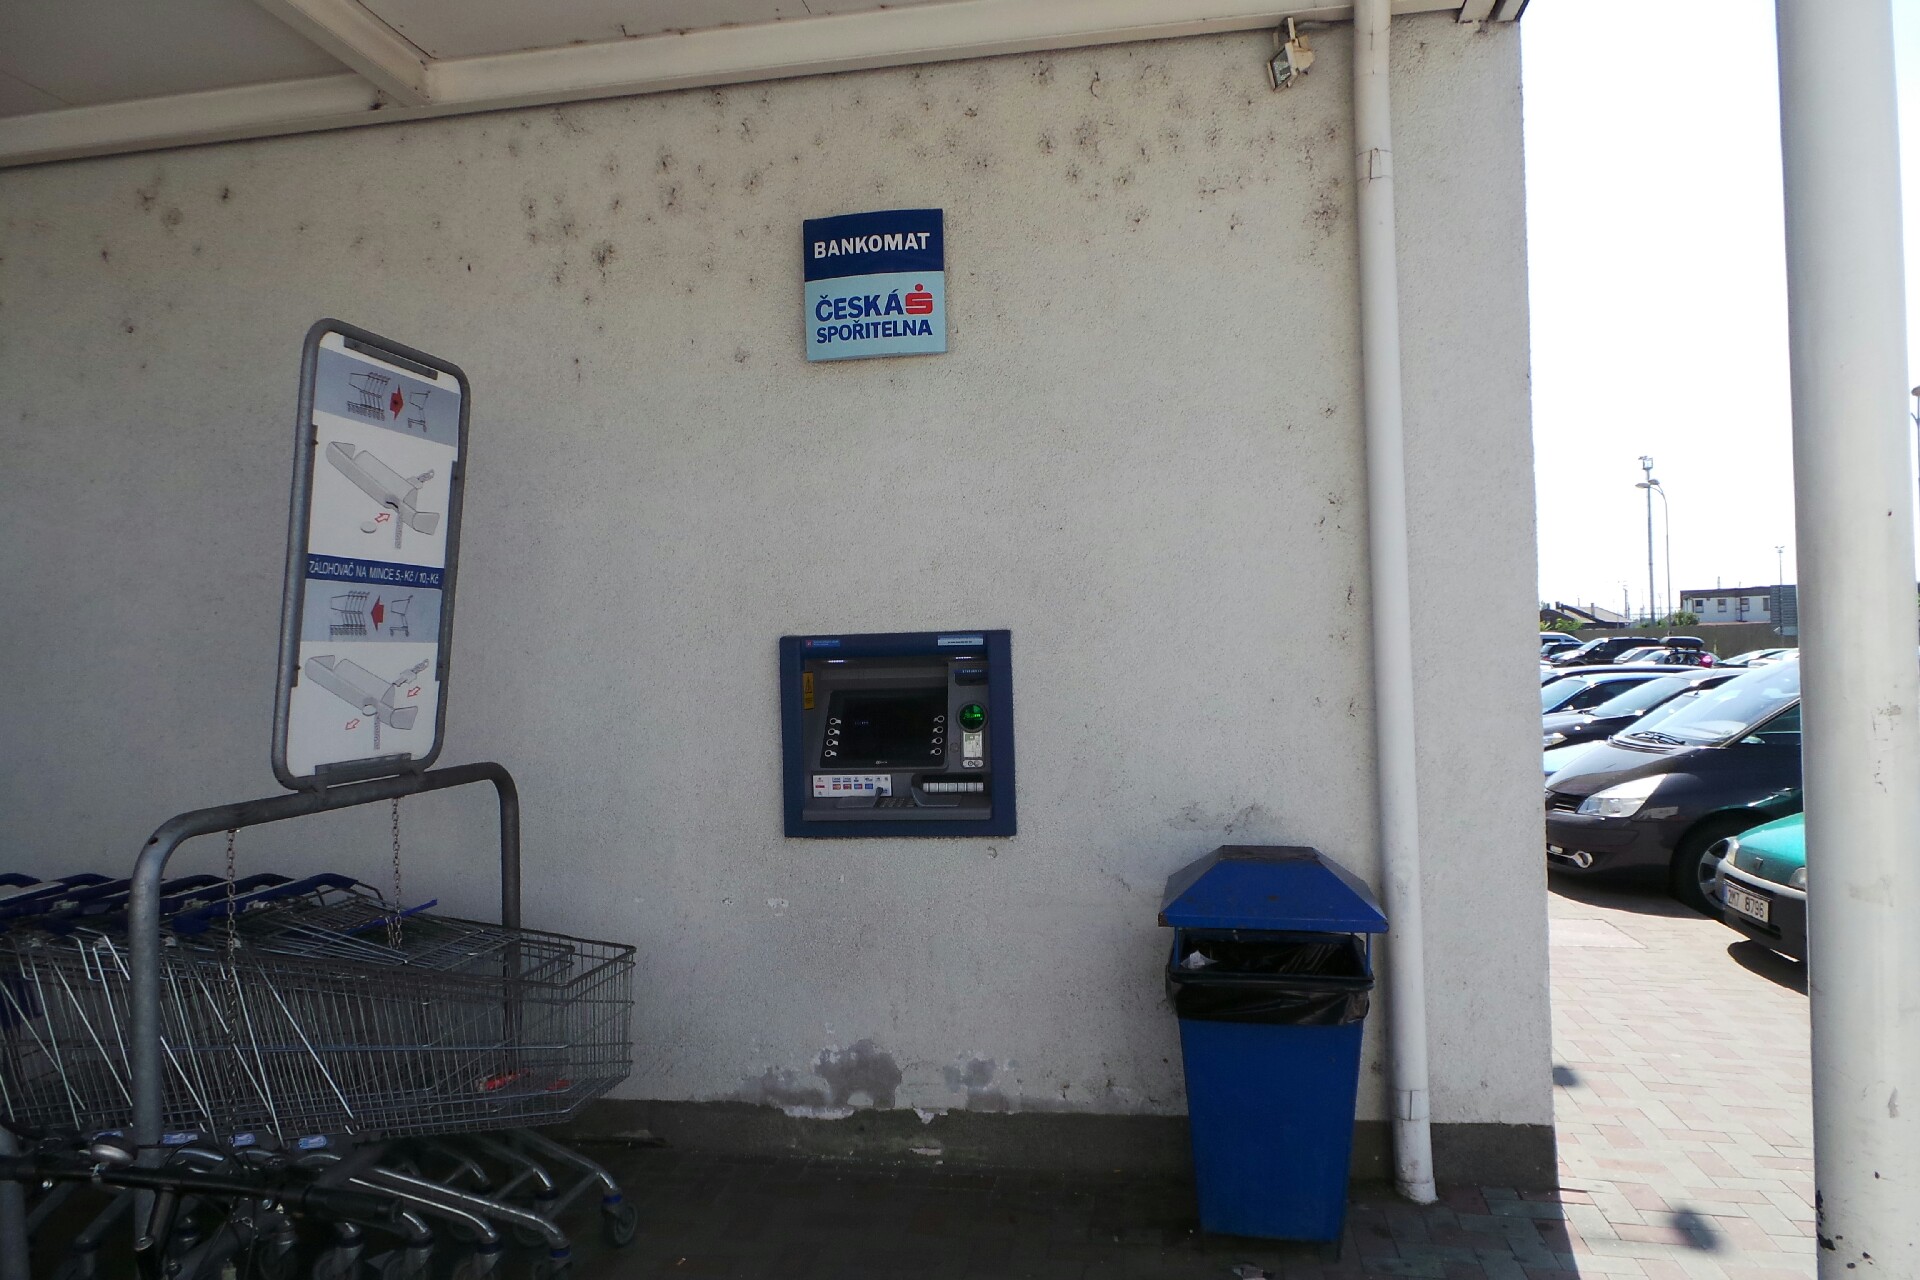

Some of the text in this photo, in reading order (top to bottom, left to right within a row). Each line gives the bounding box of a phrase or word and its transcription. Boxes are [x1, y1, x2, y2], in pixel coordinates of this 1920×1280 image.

[814, 232, 930, 259] BANKOMAT
[815, 288, 904, 322] ČESKÁ
[816, 319, 933, 344] SPOŘITELNA
[309, 558, 354, 577] ZÁLOHOVAČ
[356, 565, 367, 578] NA
[369, 567, 394, 580] MINCE
[1744, 896, 1764, 918] 8796
